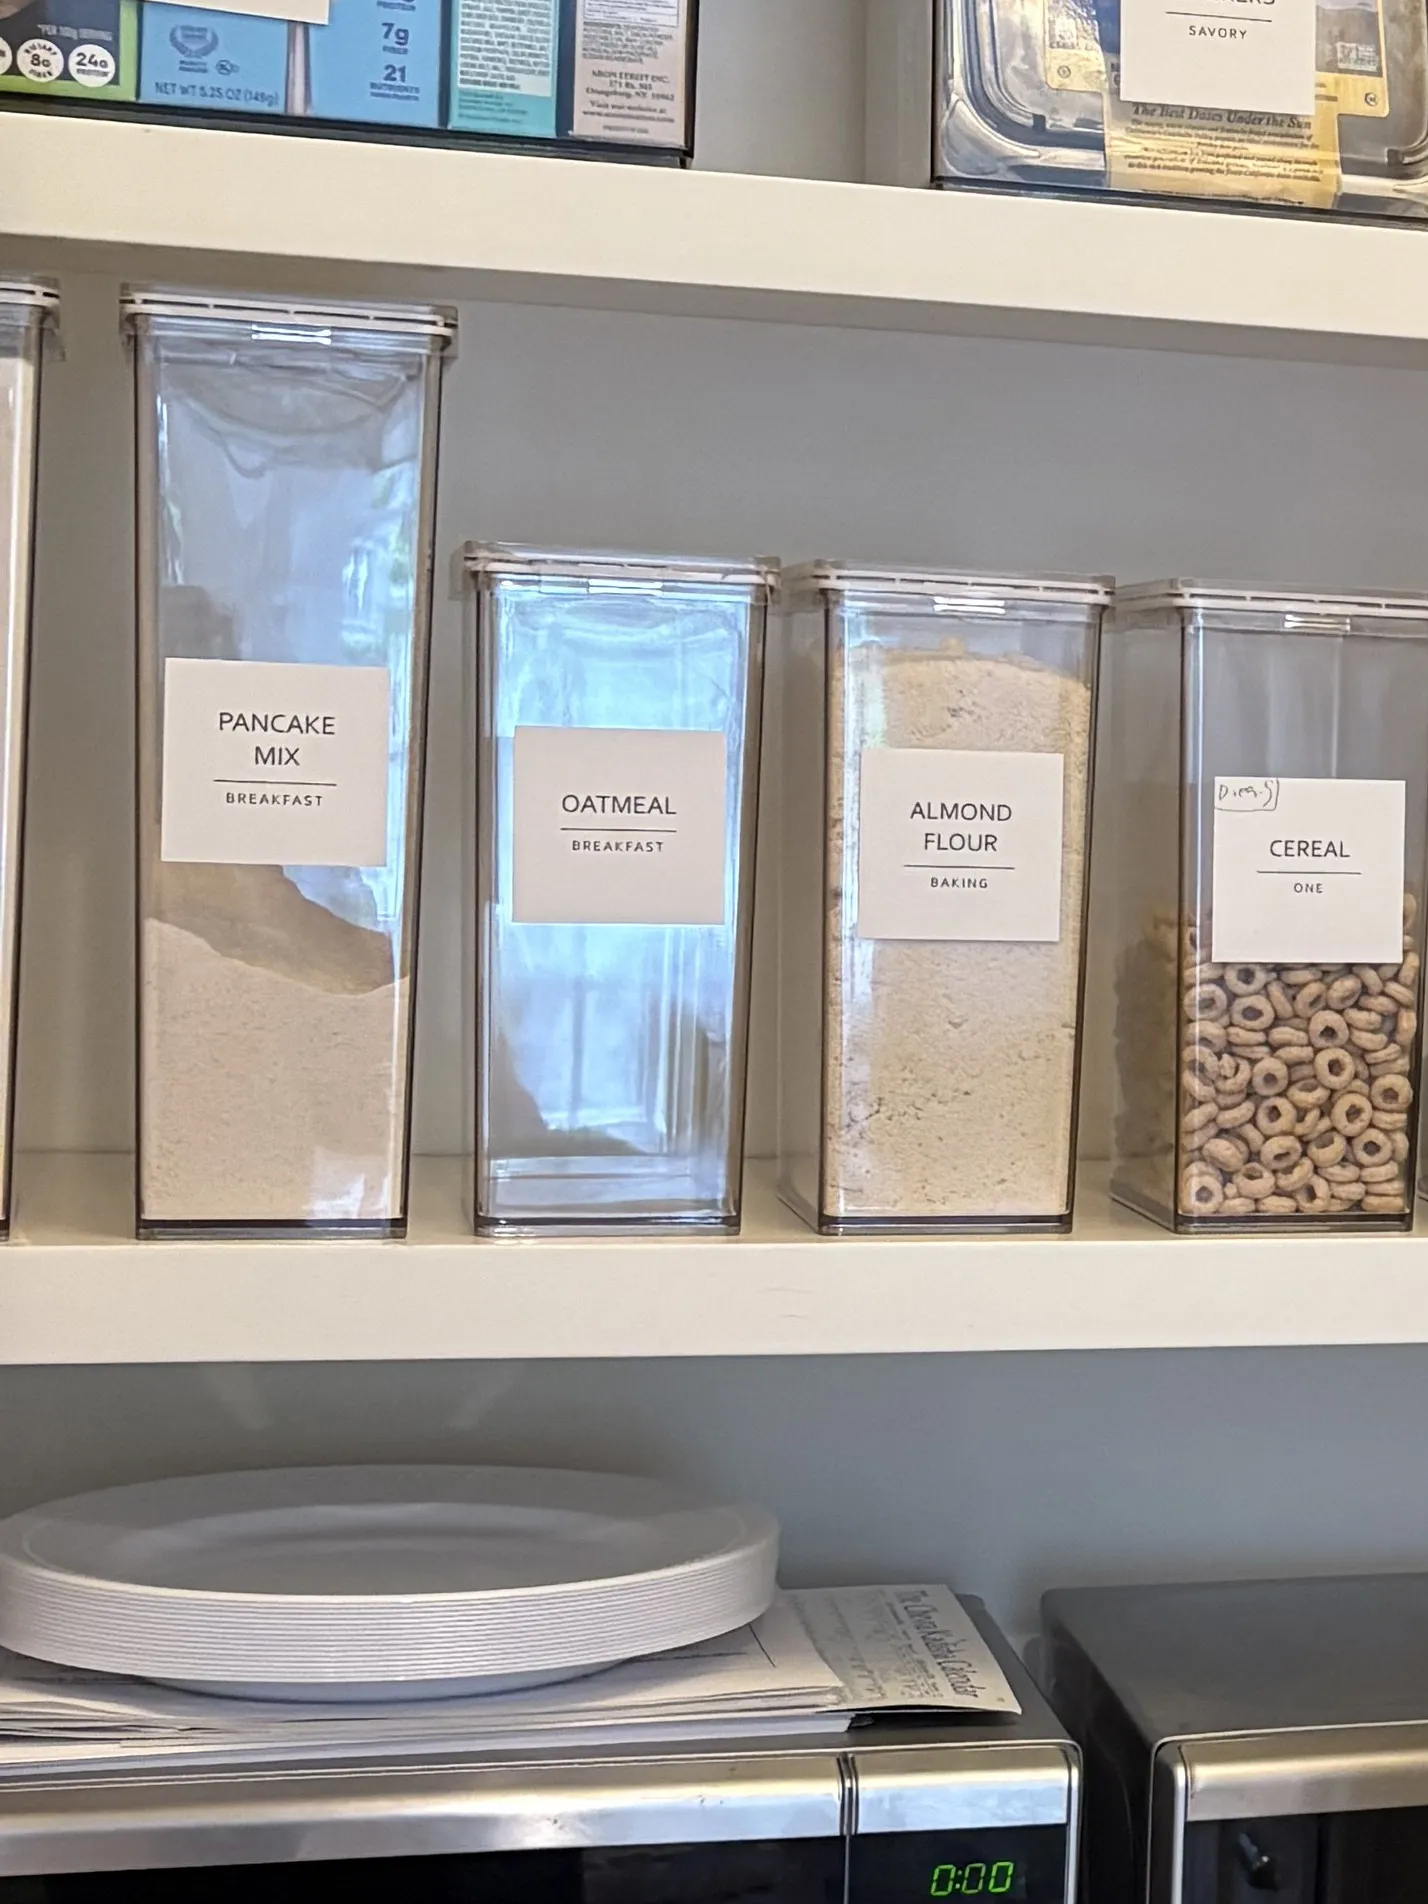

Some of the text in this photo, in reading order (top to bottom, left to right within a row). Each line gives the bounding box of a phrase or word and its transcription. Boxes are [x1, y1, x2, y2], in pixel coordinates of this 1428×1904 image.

[381, 22, 410, 46] 7g
[1188, 24, 1248, 40] SAVORY
[383, 64, 407, 82] 21
[217, 711, 336, 738] PANCAKE
[252, 744, 301, 768] MIX
[225, 791, 323, 809] BREAKFAST
[561, 792, 677, 818] OATMEAL
[909, 800, 1013, 825] ALMOND
[572, 839, 664, 855] BREAKFAST
[923, 831, 999, 853] FLOUR
[1269, 839, 1351, 860] CEREAL
[930, 876, 989, 891] BAKING
[1293, 882, 1324, 896] ONE
[930, 1860, 1015, 1897] 0:00
